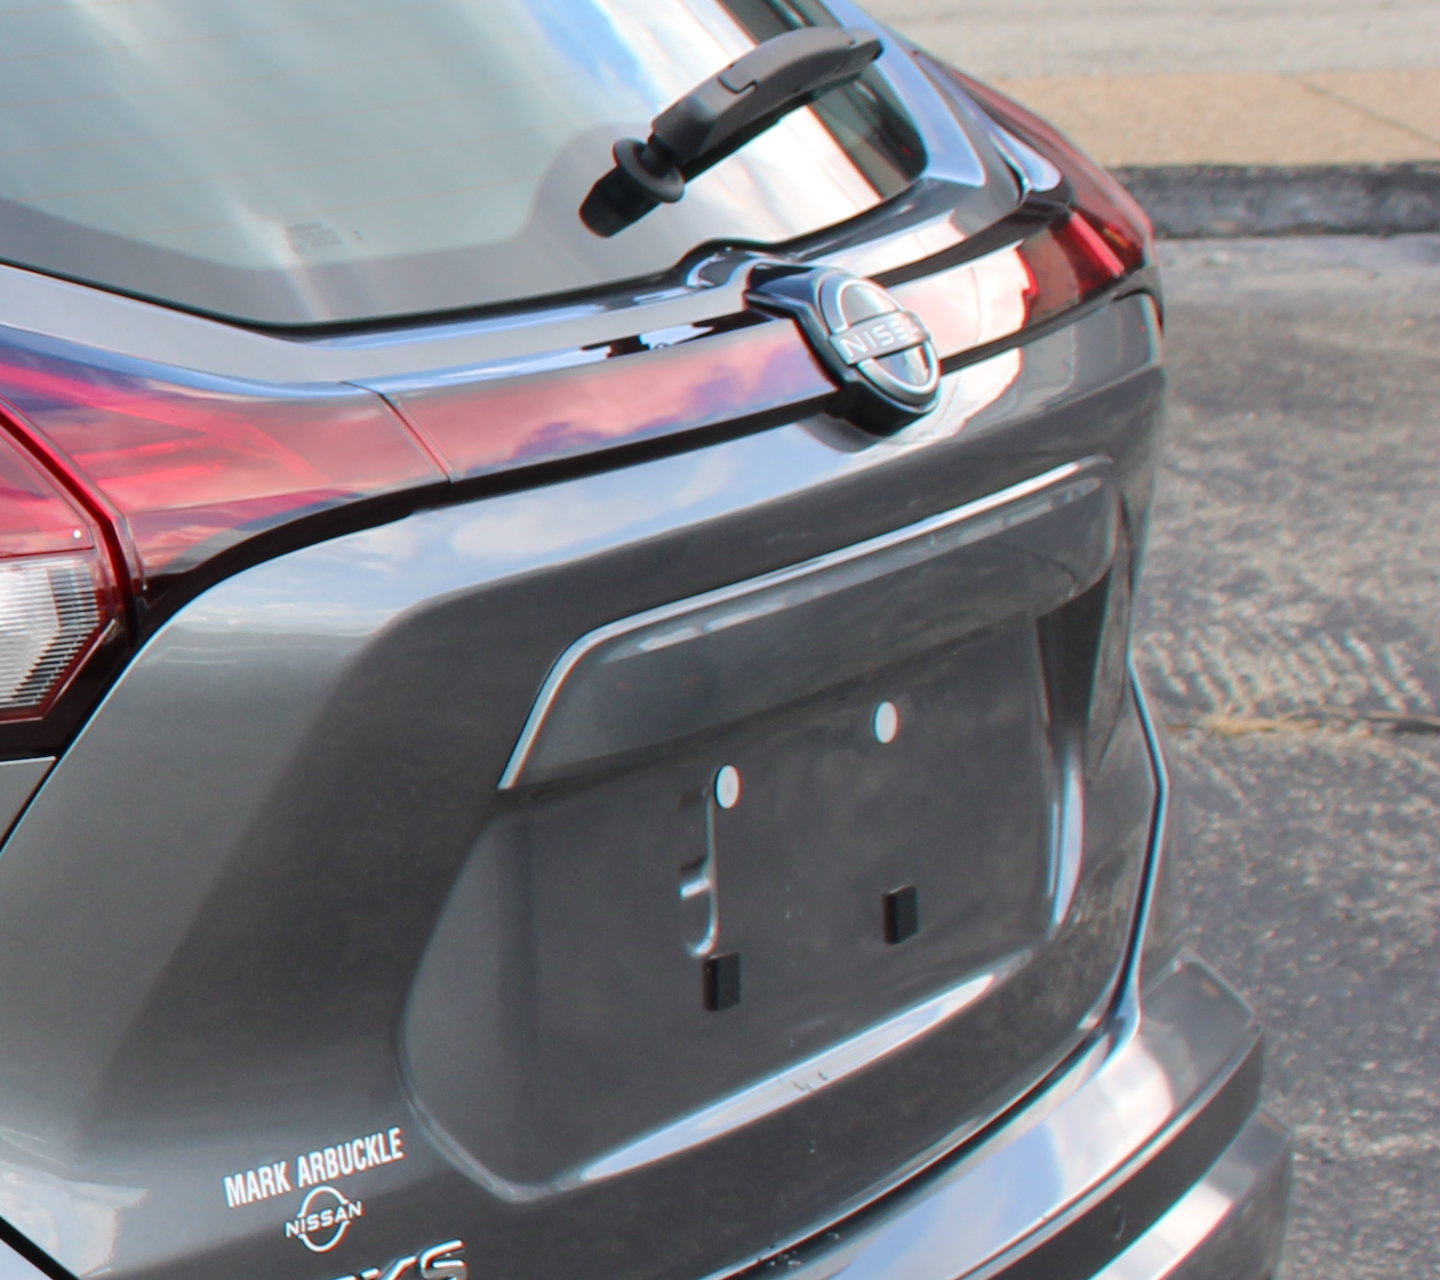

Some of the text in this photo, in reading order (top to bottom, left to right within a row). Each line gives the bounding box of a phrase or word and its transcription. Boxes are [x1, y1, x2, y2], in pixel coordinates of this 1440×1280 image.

[223, 1127, 405, 1208] MARK ARBUCKLE
[284, 1200, 365, 1239] NISSAN
